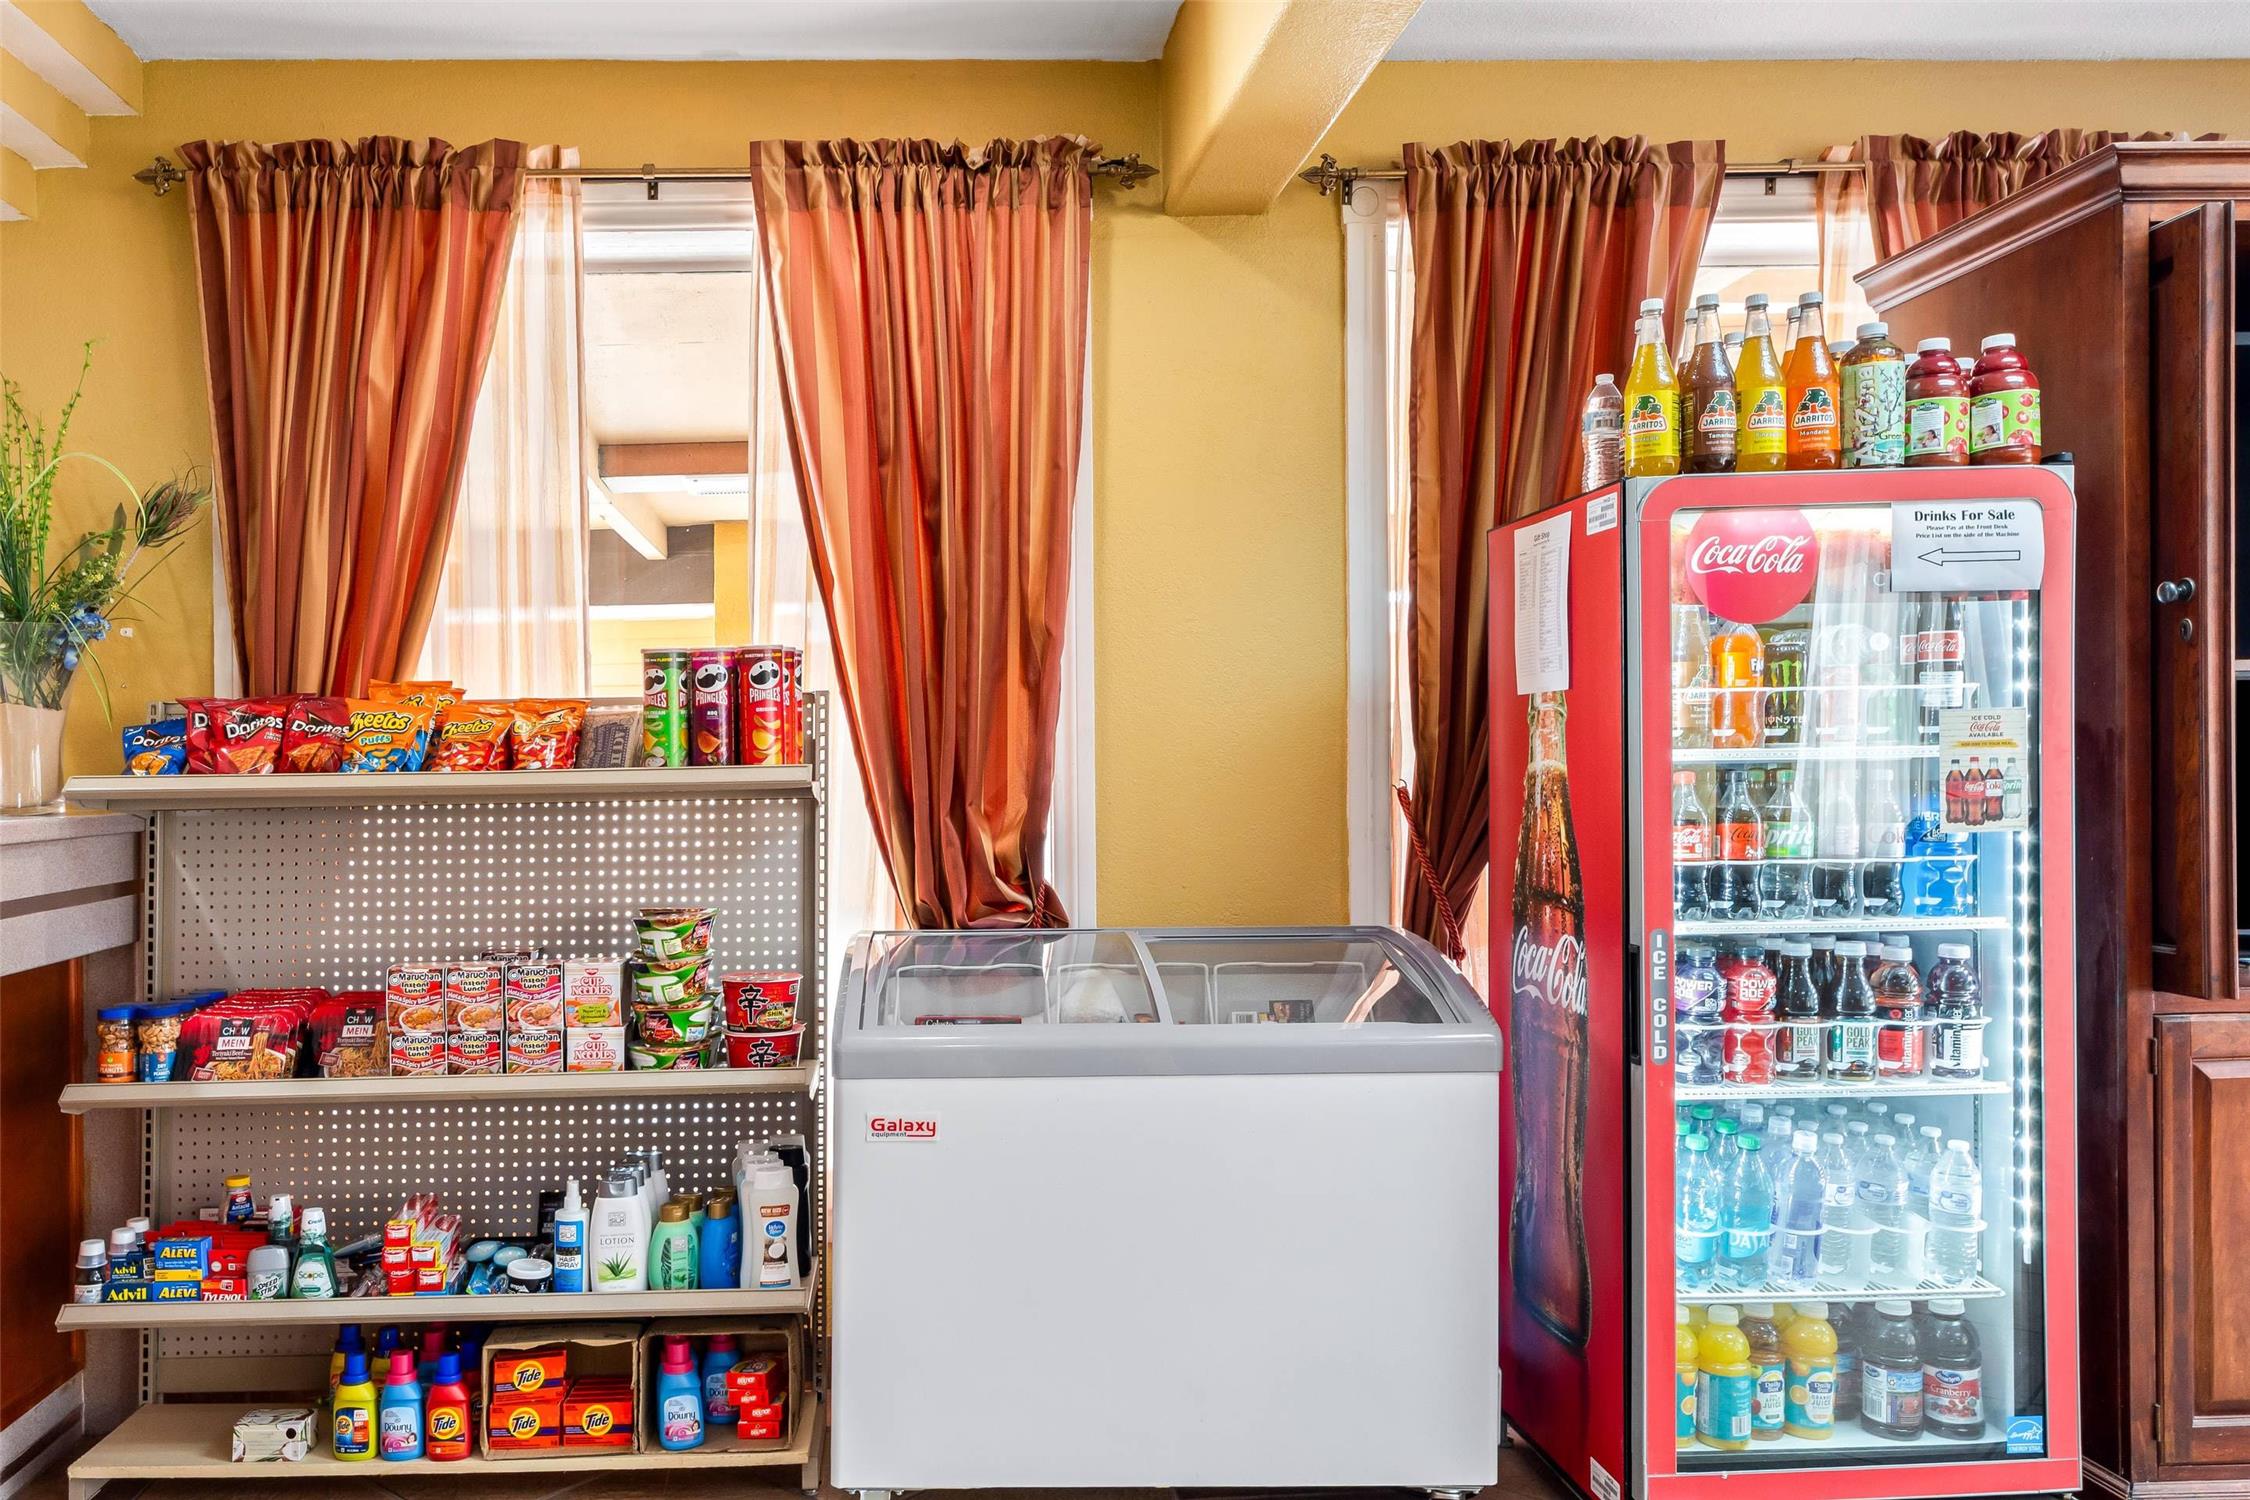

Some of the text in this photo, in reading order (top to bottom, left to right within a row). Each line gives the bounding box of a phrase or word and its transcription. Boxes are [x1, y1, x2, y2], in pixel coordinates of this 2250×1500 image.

[1796, 414, 1833, 425] JARRITOS
[1914, 509, 2016, 522] Drinks For Sale
[1691, 535, 1812, 575] Coca-Cola
[695, 690, 728, 707] PRINGLES
[749, 687, 781, 704] PRINGLES
[226, 715, 283, 739] Doritos
[291, 720, 350, 737] Doritos
[347, 711, 411, 738] Cheetos
[441, 720, 494, 742] Cheetos
[359, 734, 391, 746] Puffs
[1867, 826, 1905, 844] Cok
[1652, 934, 1667, 980] ICE
[399, 972, 440, 981] Maruchan
[457, 970, 500, 980] Maruchan
[517, 967, 559, 977] Maruchan
[1513, 925, 1587, 1016] Coca-Cola
[402, 981, 430, 989] Instant
[520, 976, 548, 984] Instant
[580, 976, 604, 986] CUP
[571, 985, 613, 996] NOODLES
[737, 984, 770, 1025] 辛
[346, 1015, 374, 1024] CHW
[222, 1026, 251, 1036] CHW
[346, 1027, 369, 1035] MEIN
[1652, 998, 1668, 1060] COLD
[1846, 1026, 1871, 1038] GOLD
[402, 1036, 443, 1045] Maruchan
[457, 1034, 498, 1042] Maruchan
[517, 1033, 559, 1041] Maruchan
[1901, 1008, 1913, 1068] vitaminwer
[1950, 1008, 1963, 1067] vitaminwer
[221, 1039, 246, 1048] MEIN
[405, 1044, 433, 1052] Instant
[584, 1041, 608, 1051] CUP
[1846, 1038, 1871, 1049] PEAK
[574, 1050, 617, 1060] NOODLES
[871, 1118, 937, 1137] Galaxy
[600, 1236, 635, 1246] LOTION
[160, 1246, 197, 1259] ALEVE
[113, 1264, 137, 1275] Advil
[298, 1270, 325, 1281] Scope
[257, 1278, 278, 1290] SPEED
[107, 1287, 147, 1301] Advil
[159, 1287, 198, 1299] ALEVE
[260, 1284, 278, 1297] STICK
[515, 1366, 542, 1387] Tide
[1930, 1384, 1972, 1397] Cranberry
[1763, 1401, 1782, 1409] JUICE
[585, 1411, 610, 1430] Tide
[668, 1411, 696, 1422] Downy
[336, 1420, 352, 1429] Tide
[384, 1422, 412, 1433] Downy
[432, 1415, 457, 1434] Tide
[511, 1415, 538, 1433] Tide
